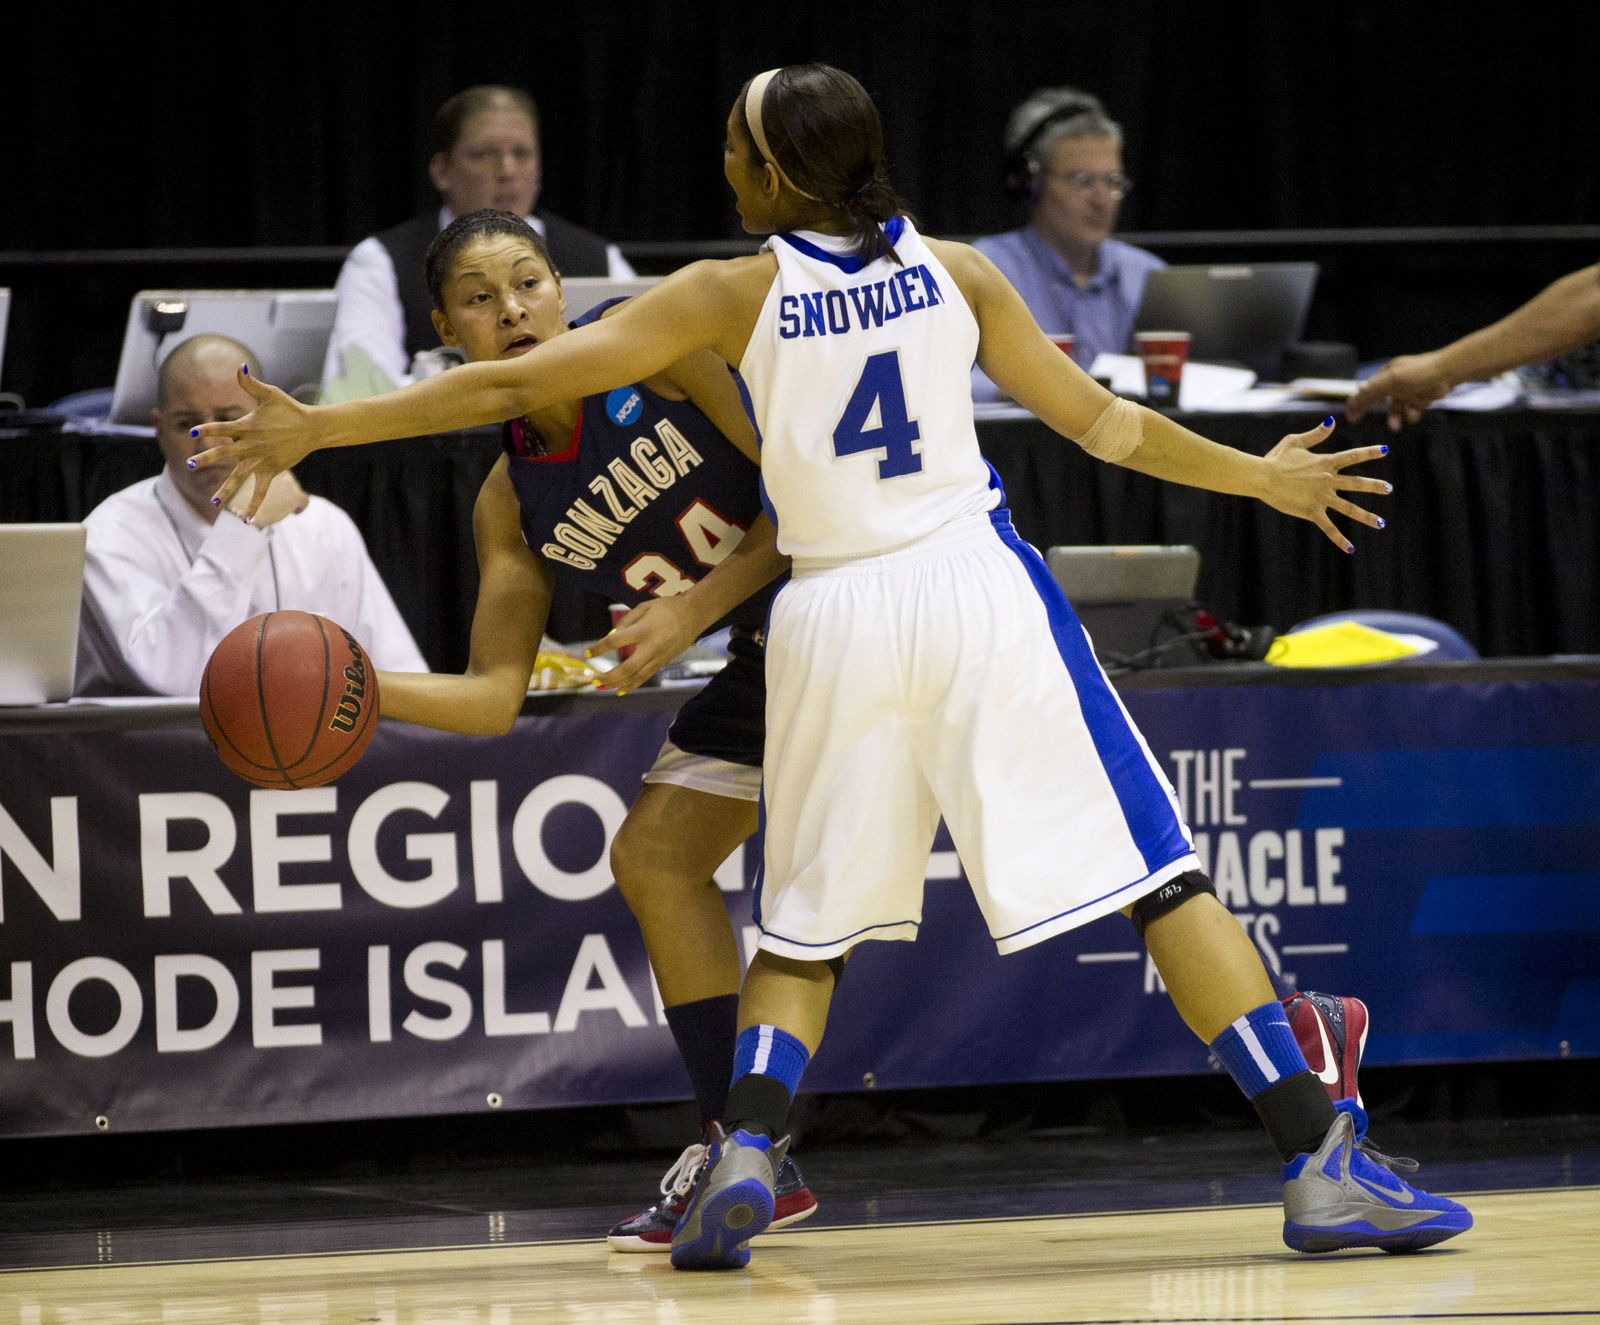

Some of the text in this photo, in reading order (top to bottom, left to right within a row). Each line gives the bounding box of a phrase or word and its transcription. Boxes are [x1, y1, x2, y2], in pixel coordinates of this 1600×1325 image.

[615, 393, 641, 424] NCAA
[827, 346, 926, 482] 4
[541, 417, 704, 571] GONZAGA
[620, 496, 750, 600] 34
[328, 627, 366, 734] Wilso
[1170, 749, 1247, 826] THE
[367, 926, 757, 1042] ISLA
